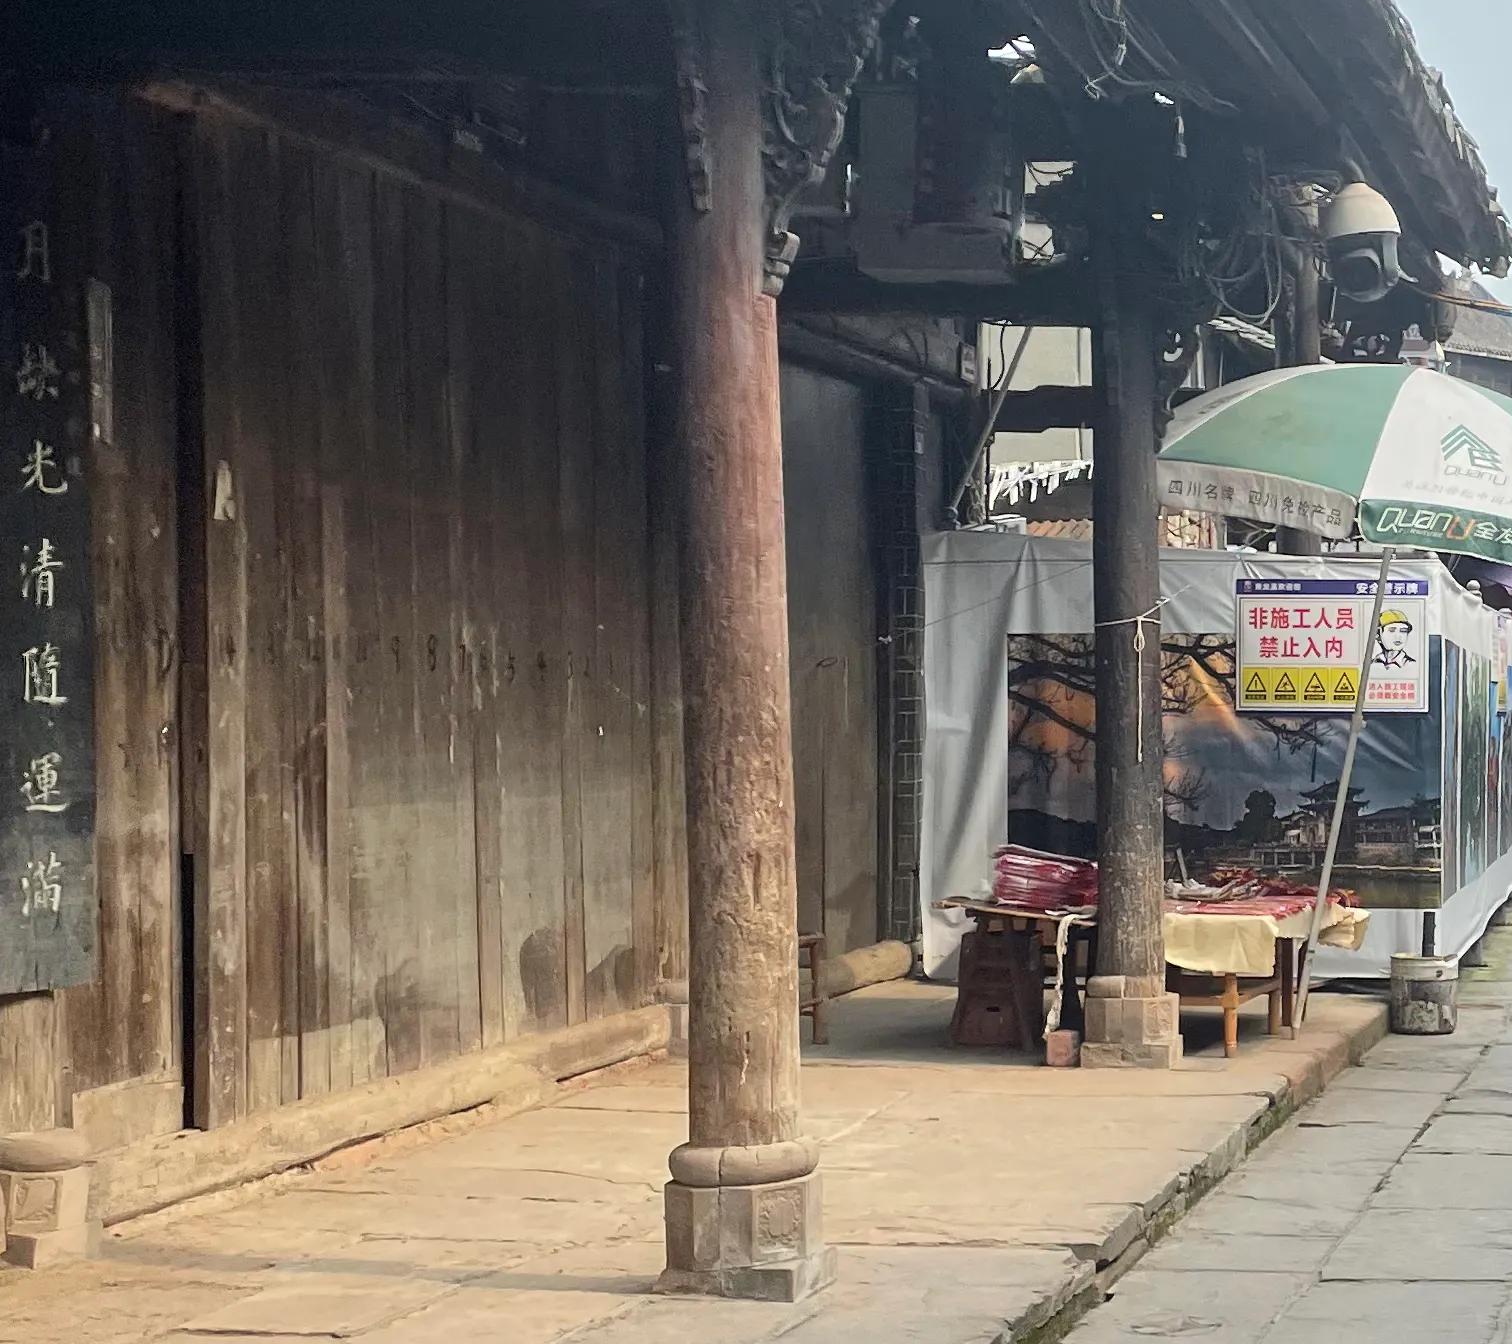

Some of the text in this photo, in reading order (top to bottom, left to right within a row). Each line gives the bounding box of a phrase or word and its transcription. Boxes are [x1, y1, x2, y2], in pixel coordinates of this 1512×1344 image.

[1248, 607, 1355, 630] 非施工人员
[1259, 635, 1343, 659] 禁止入内
